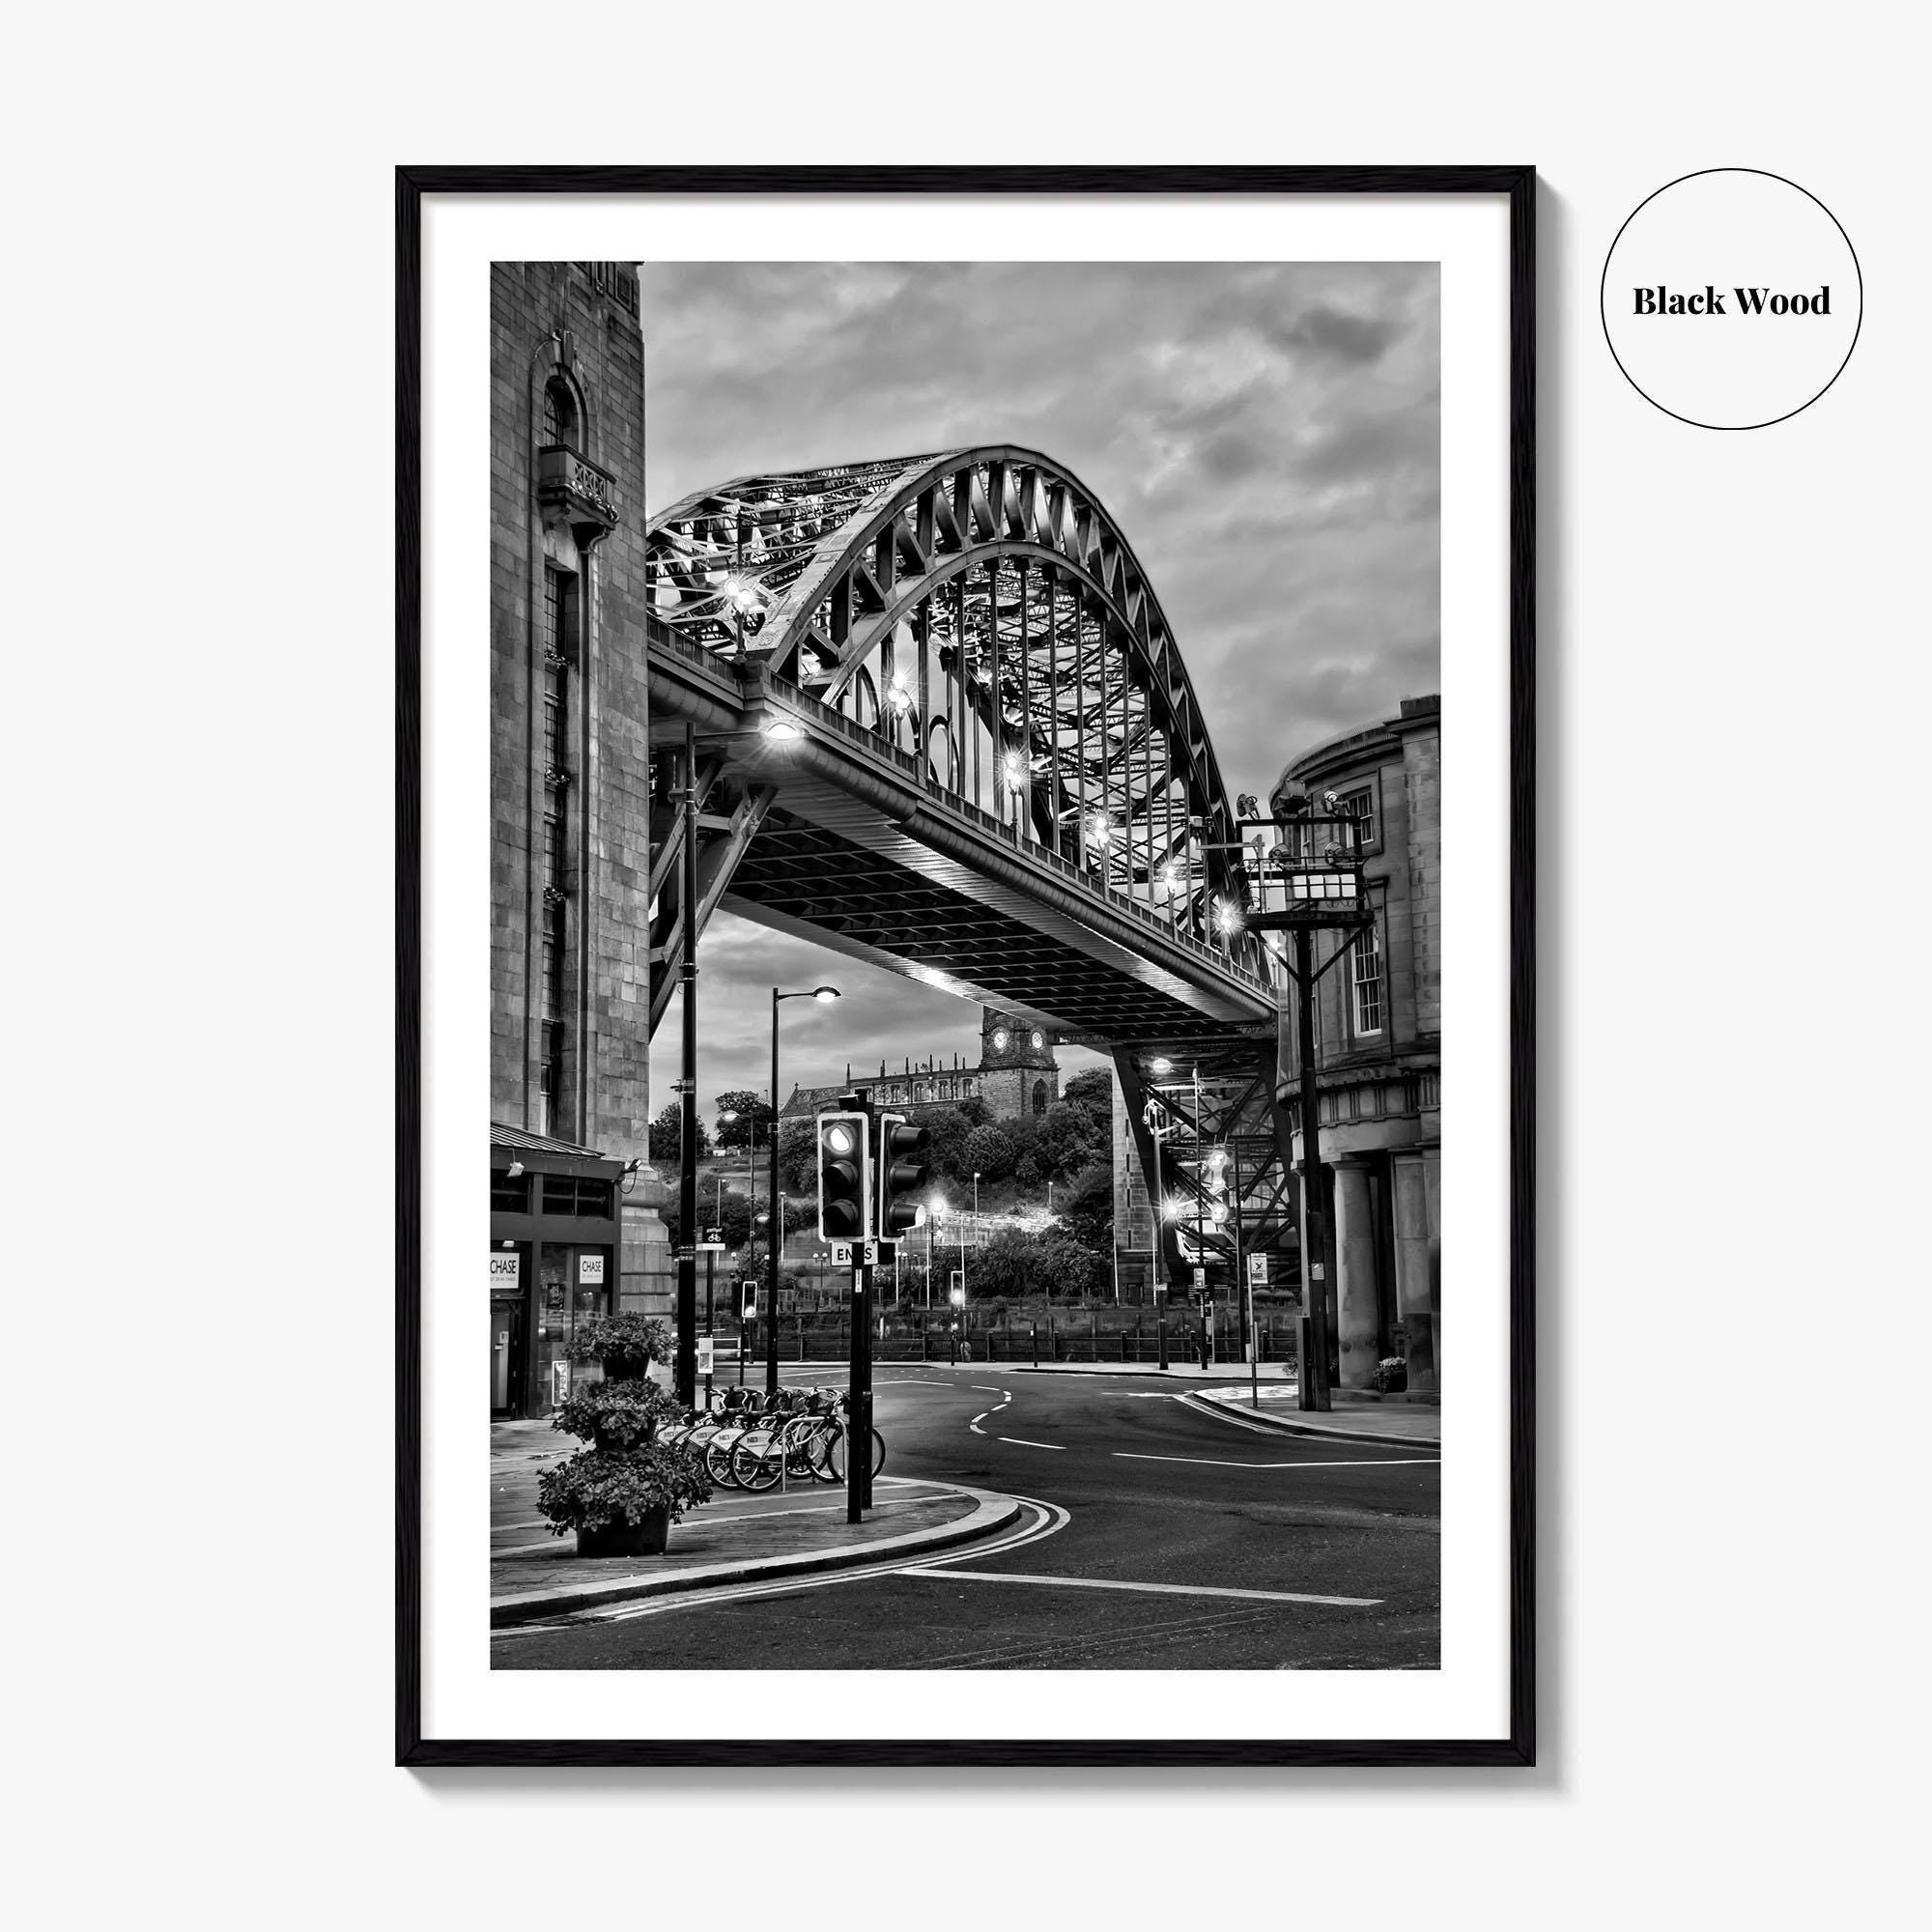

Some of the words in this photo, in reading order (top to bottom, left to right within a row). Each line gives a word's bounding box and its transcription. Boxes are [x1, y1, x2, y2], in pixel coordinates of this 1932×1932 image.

[837, 1247, 872, 1261] ENS
[490, 1259, 517, 1274] CHASE
[582, 1261, 602, 1273] CHASE
